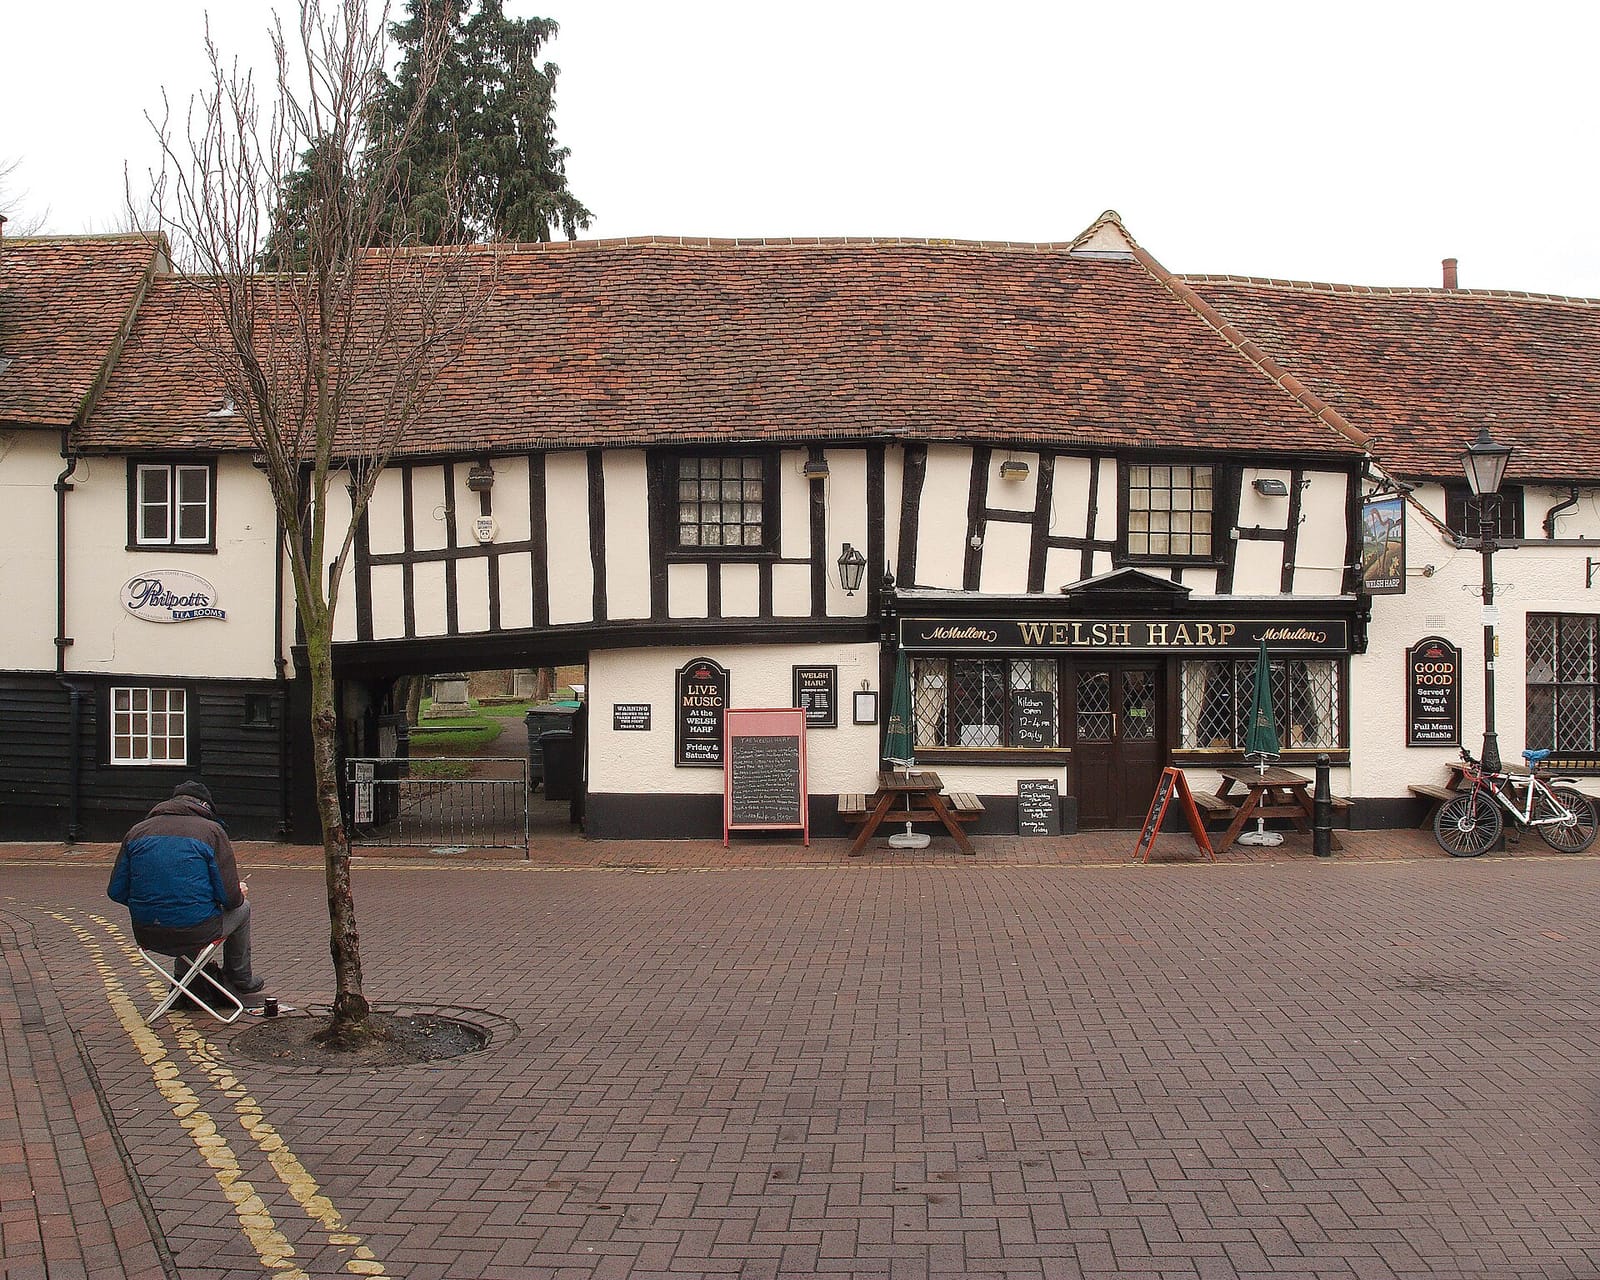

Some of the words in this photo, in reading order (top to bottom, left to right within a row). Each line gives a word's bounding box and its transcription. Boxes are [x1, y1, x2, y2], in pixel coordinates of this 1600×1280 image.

[128, 578, 209, 610] Philpott's
[175, 611, 191, 619] TEA
[193, 608, 222, 618] ROOMS
[921, 626, 998, 643] McMullen
[1017, 622, 1132, 646] WELSH
[1146, 623, 1236, 646] HARP
[1252, 627, 1327, 644] McMullen
[1415, 662, 1454, 673] GOOD
[1416, 674, 1453, 685] FOOD
[688, 685, 718, 695] LIVE
[1417, 688, 1444, 696] Served
[683, 696, 722, 707] MUSIC
[1017, 695, 1043, 707] Kitchen
[1421, 697, 1440, 705] Days
[690, 709, 700, 717] At
[701, 709, 713, 717] the
[1423, 705, 1445, 713] Week
[686, 717, 717, 725] WELSH
[690, 725, 713, 733] HARP
[1414, 723, 1430, 731] Full
[1431, 723, 1453, 731] Menu
[1019, 729, 1043, 743] Daily
[1416, 731, 1452, 739] Available
[686, 743, 711, 752] Friday
[685, 752, 720, 760] Saturday
[1020, 782, 1034, 790] OAP
